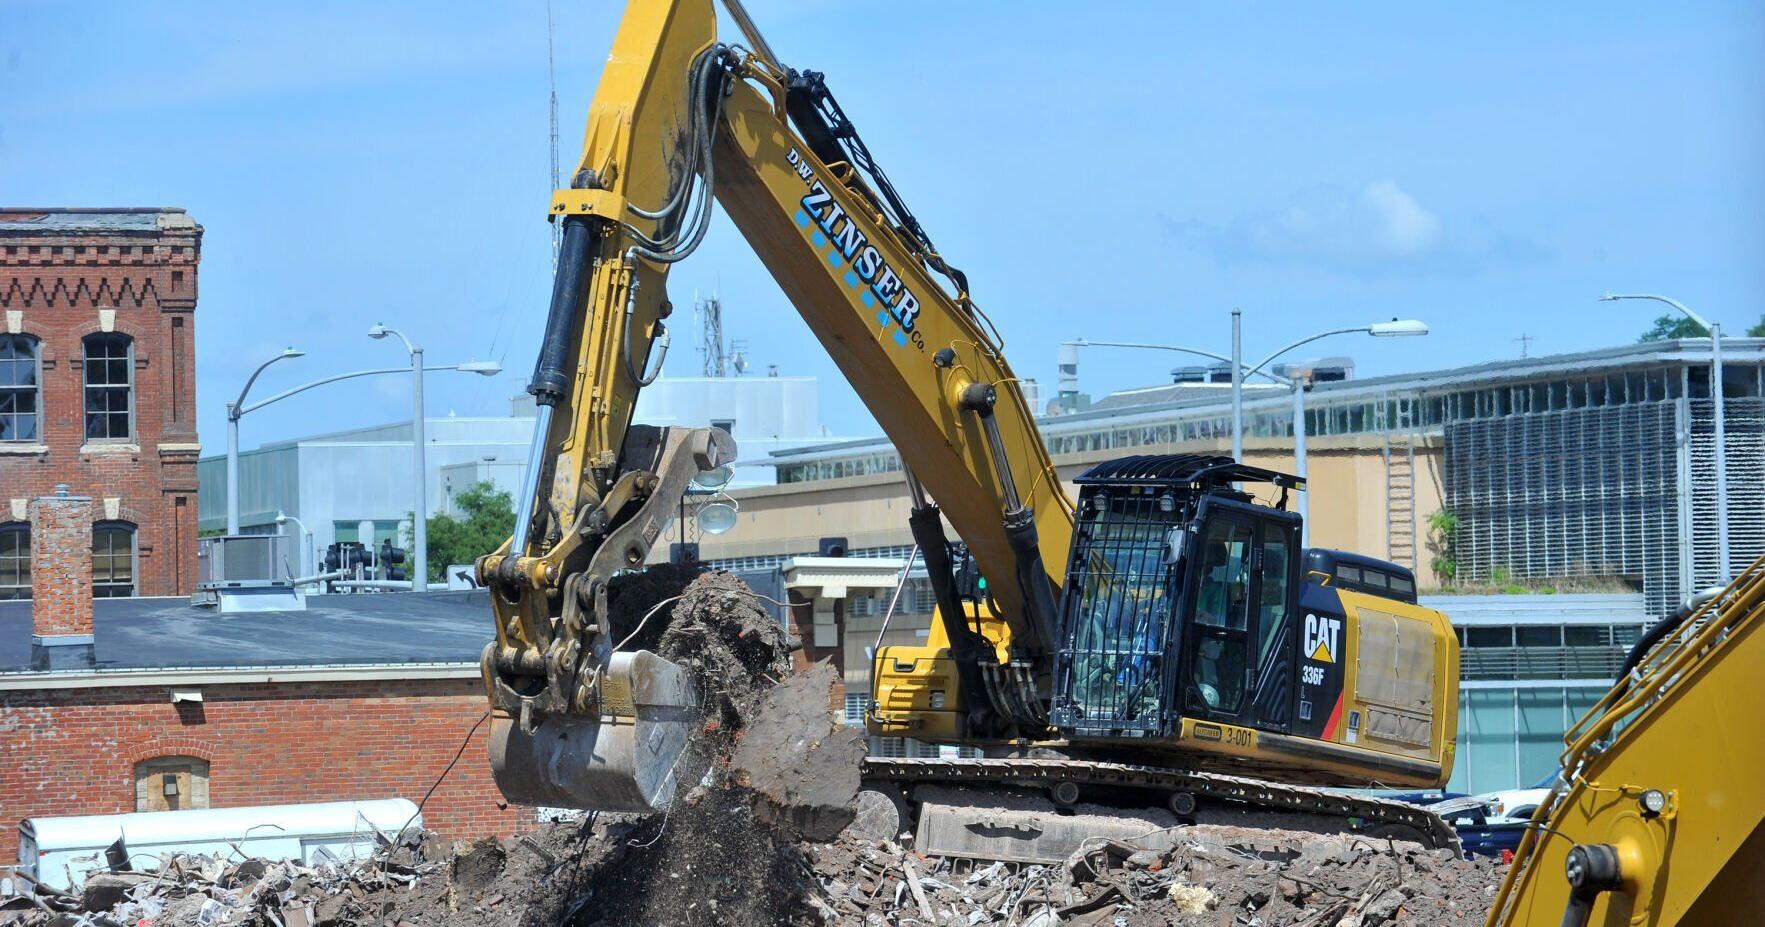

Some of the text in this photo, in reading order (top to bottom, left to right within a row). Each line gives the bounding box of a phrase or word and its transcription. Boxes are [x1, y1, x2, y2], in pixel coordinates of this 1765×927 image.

[786, 146, 925, 353] D.W. ZINSER Co.
[1304, 613, 1341, 663] CAT
[1302, 665, 1325, 686] 336F
[1226, 727, 1252, 747] 3-001
